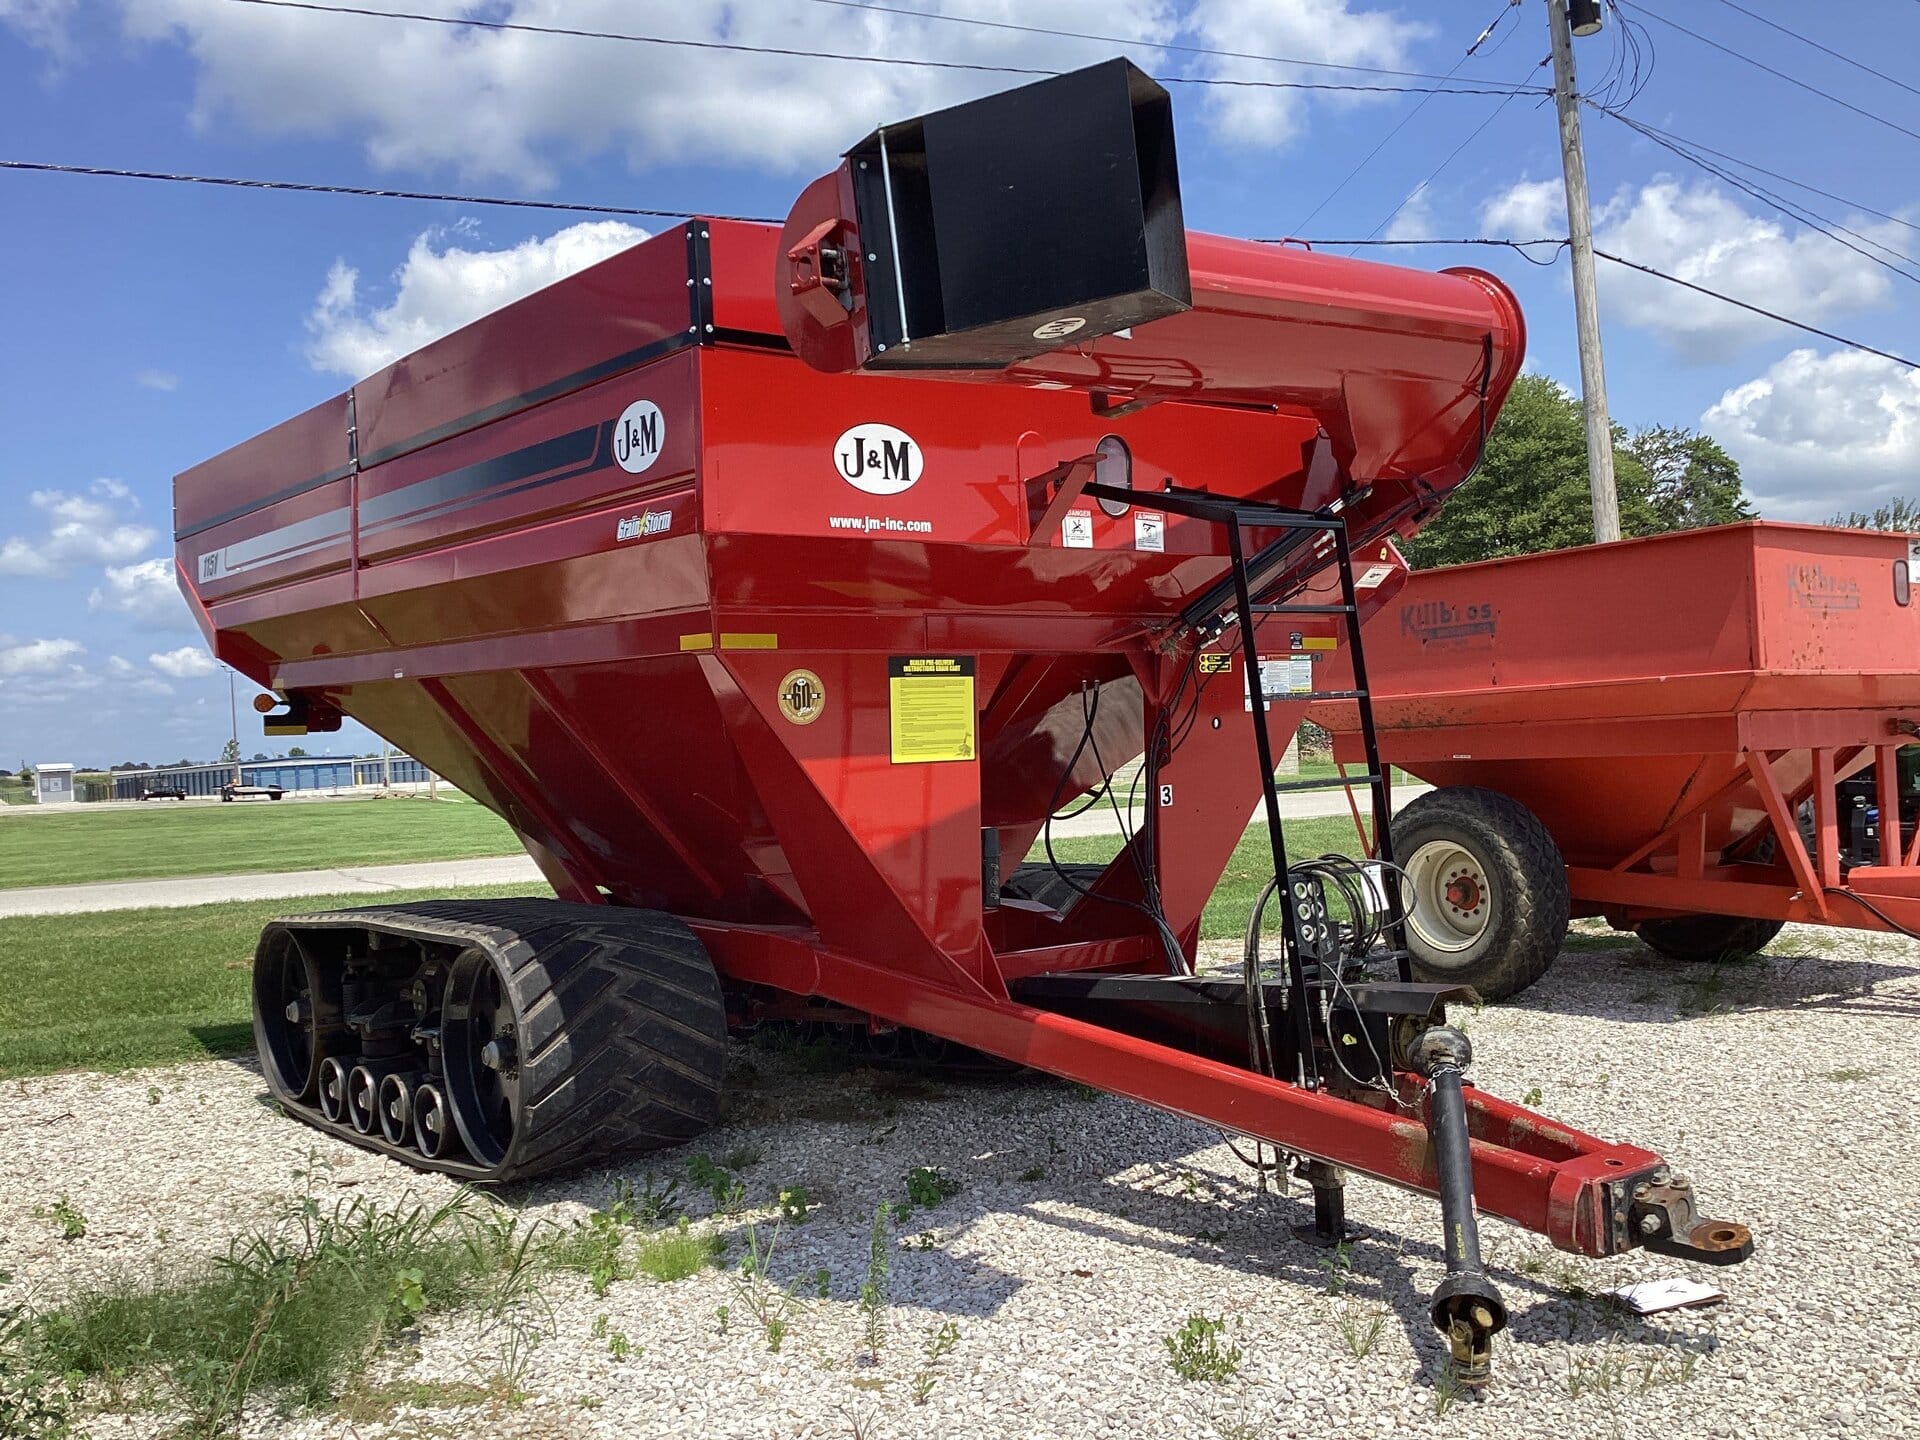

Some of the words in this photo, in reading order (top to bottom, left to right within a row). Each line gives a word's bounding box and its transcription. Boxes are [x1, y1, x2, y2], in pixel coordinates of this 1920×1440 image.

[617, 410, 658, 462] J&M
[840, 436, 912, 482] J&M
[617, 517, 641, 541] Grain
[644, 510, 672, 535] Storm
[829, 516, 933, 533] www.jm-inc.com
[1162, 786, 1171, 805] 3
